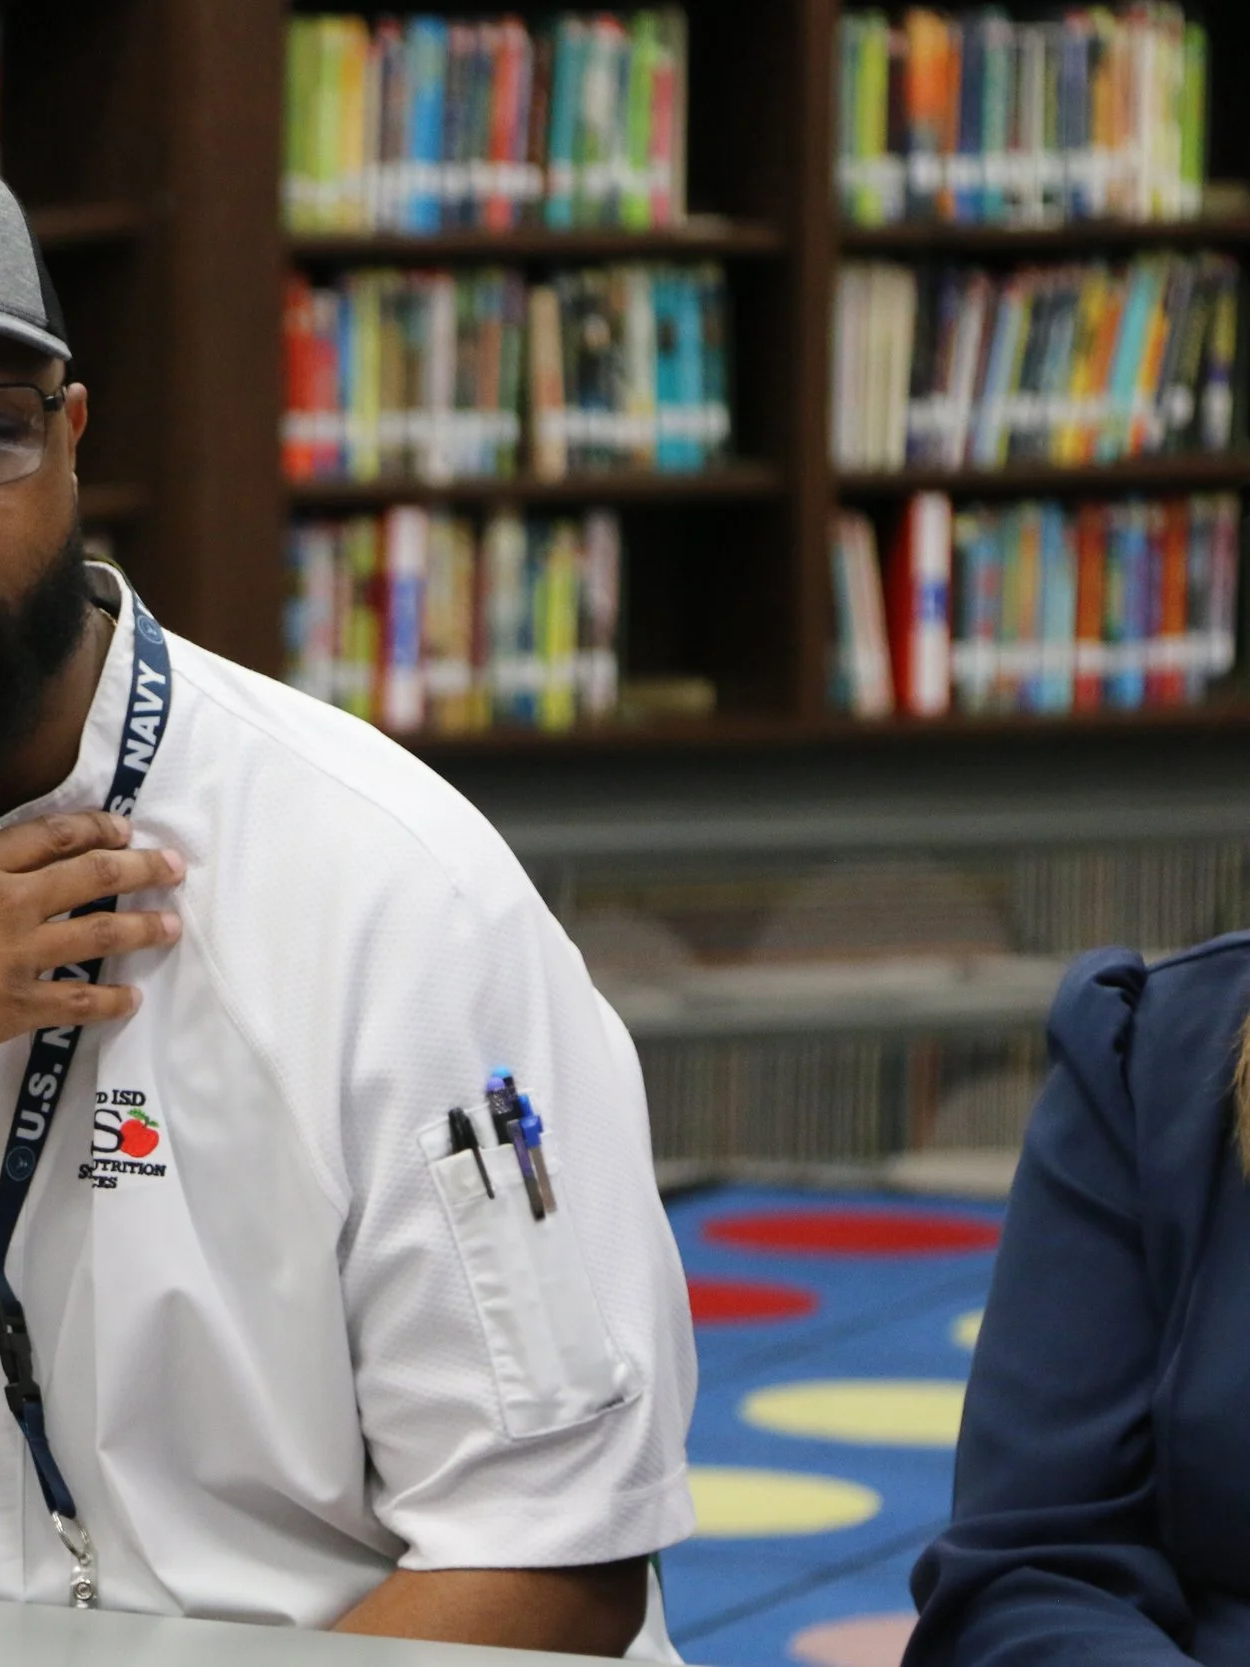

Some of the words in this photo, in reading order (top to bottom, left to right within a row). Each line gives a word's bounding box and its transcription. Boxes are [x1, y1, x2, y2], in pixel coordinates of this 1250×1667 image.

[123, 659, 166, 773] NAVY
[16, 1063, 64, 1141] U.S.
[111, 1089, 146, 1106] ISD
